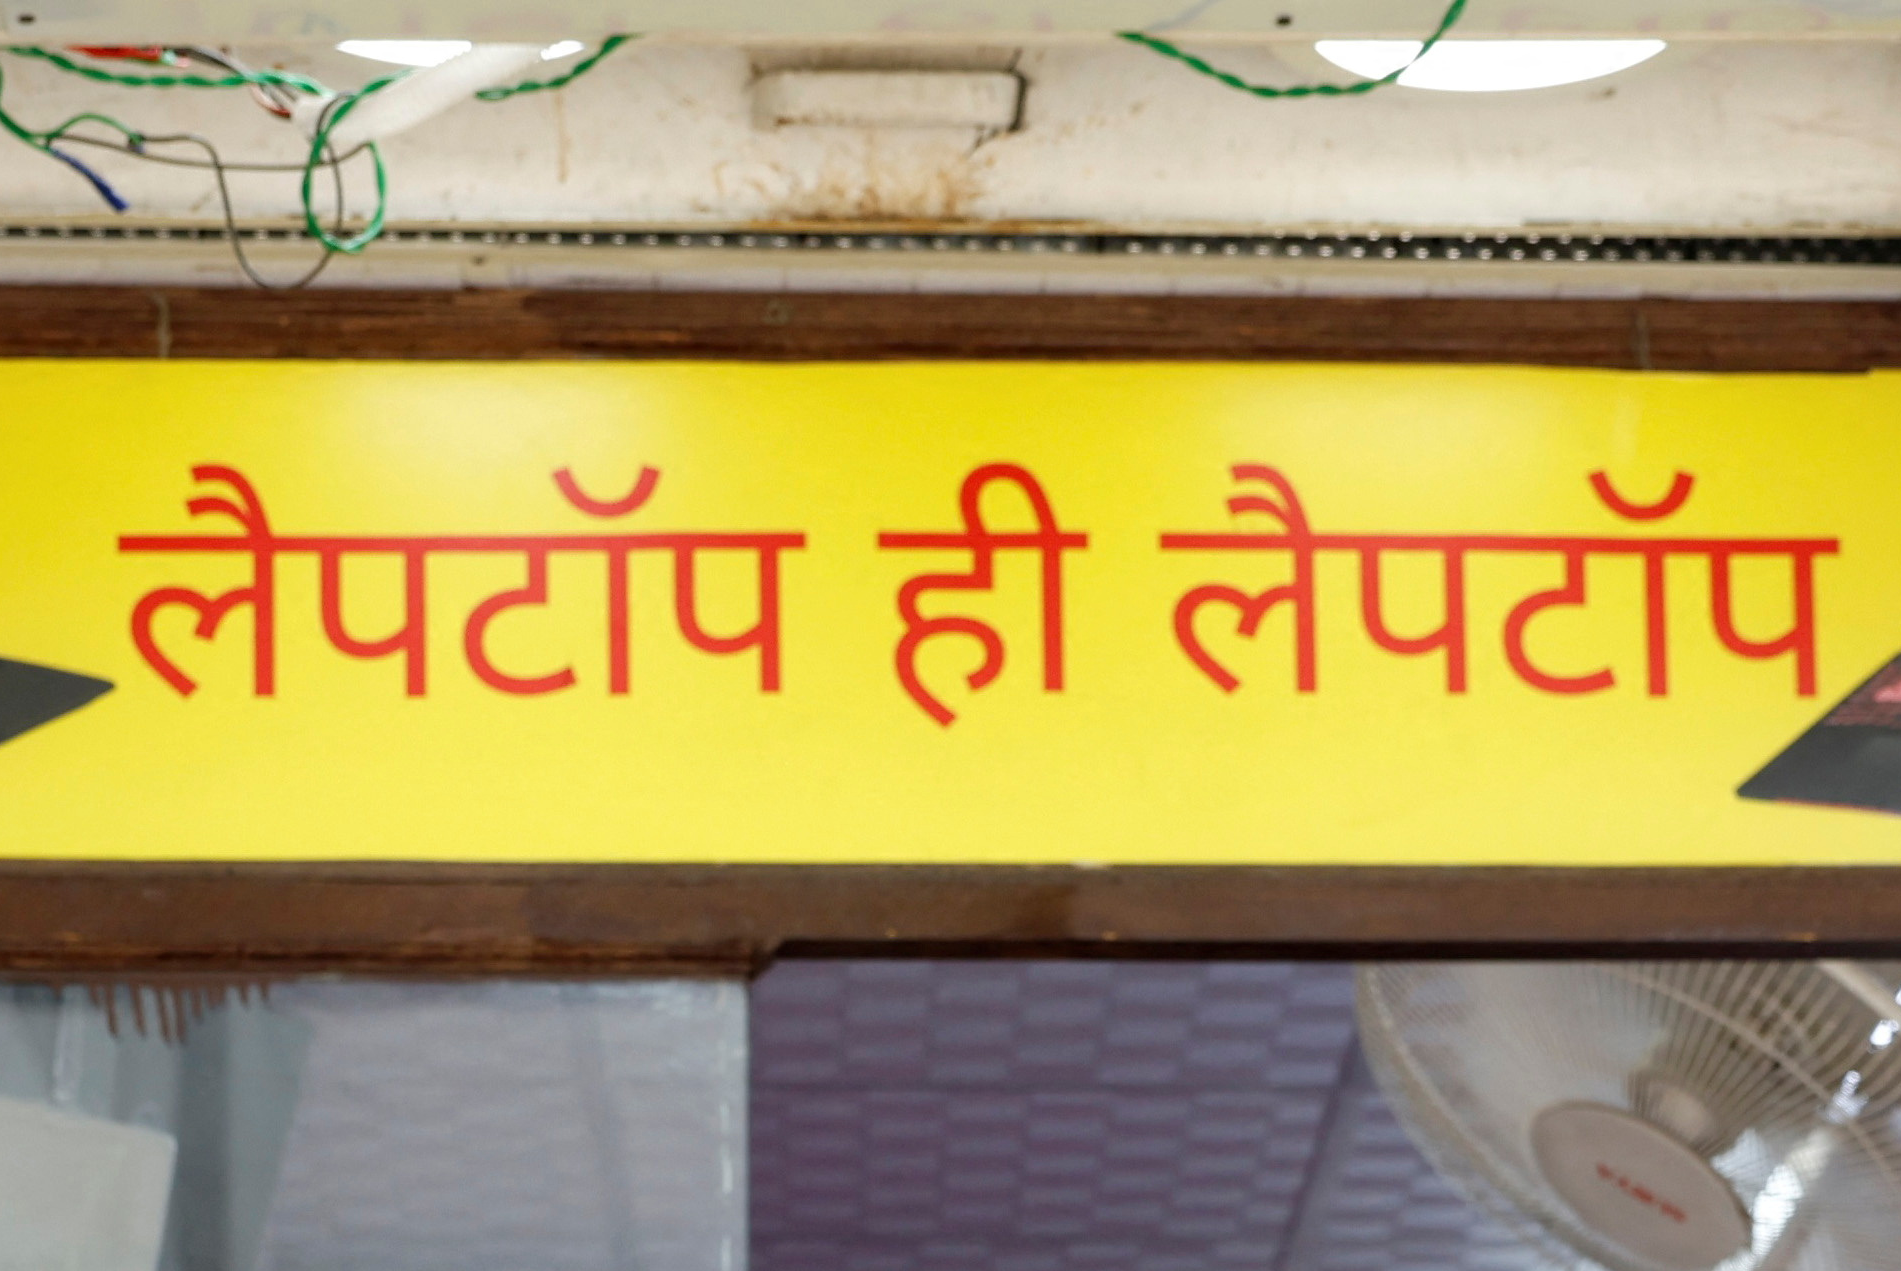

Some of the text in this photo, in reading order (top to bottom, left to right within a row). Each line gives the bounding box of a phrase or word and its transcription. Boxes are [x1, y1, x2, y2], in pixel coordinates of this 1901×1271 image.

[118, 462, 1840, 727] लैपटॉप ही लैपटॉप
